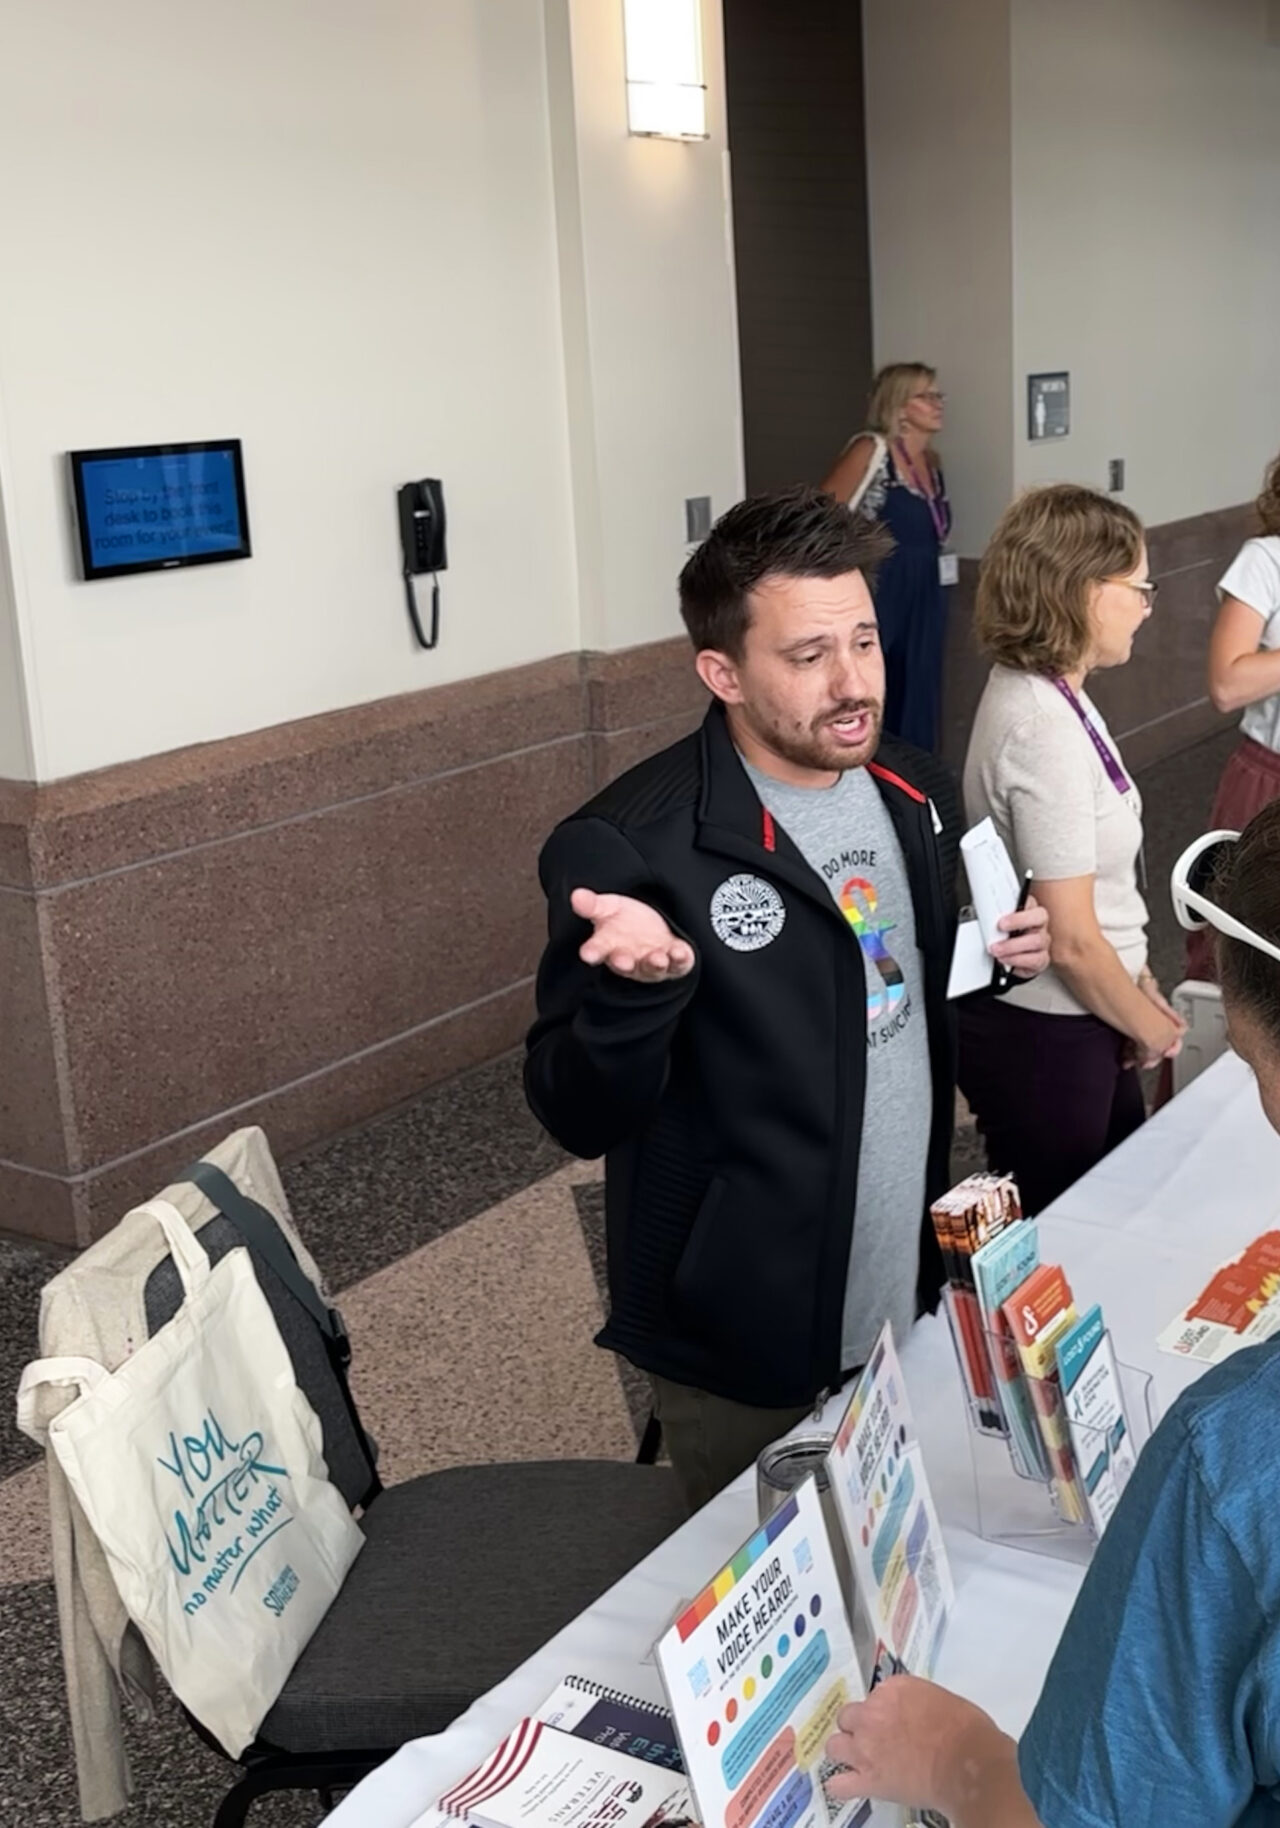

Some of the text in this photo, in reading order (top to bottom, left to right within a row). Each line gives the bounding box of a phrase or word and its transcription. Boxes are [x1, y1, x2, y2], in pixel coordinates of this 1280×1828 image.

[95, 532, 134, 550] room
[136, 528, 155, 545] for
[104, 508, 139, 527] desk
[142, 508, 158, 523] to
[821, 849, 878, 880] DO MORE
[157, 1407, 240, 1499] YOU
[184, 1591, 208, 1616] no
[202, 1535, 245, 1594] matter
[245, 1484, 284, 1538] what
[715, 1592, 752, 1645] MAKE
[751, 1556, 783, 1601] YOUR
[717, 1625, 753, 1675] VOICE
[752, 1574, 794, 1634] HEARD!
[547, 1769, 605, 1824] VETERANS
